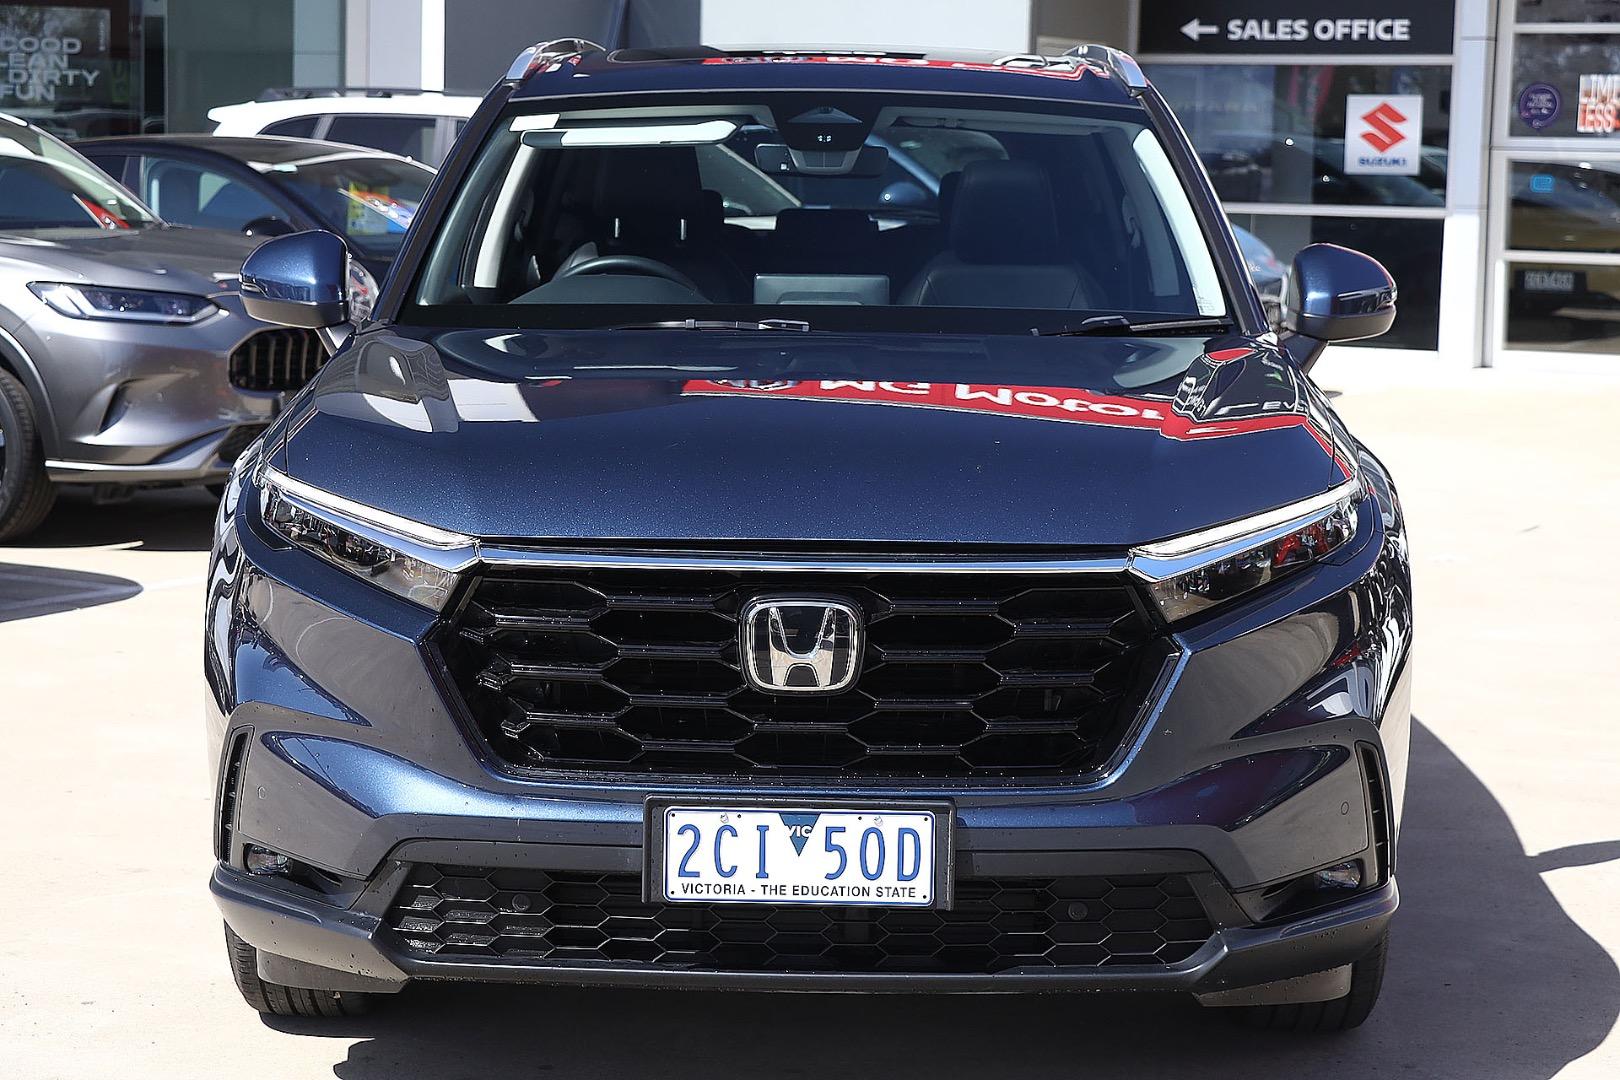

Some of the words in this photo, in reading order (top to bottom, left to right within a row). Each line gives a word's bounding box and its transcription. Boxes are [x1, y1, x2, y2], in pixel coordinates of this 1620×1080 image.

[1227, 18, 1309, 41] SALES
[1313, 18, 1411, 41] OFFICE
[1358, 157, 1407, 168] SUZUKI
[785, 824, 814, 838] VIC
[681, 882, 746, 896] VICTORIA
[760, 884, 787, 897] THE
[792, 884, 873, 898] EDUCATION
[876, 885, 917, 898] STATE
